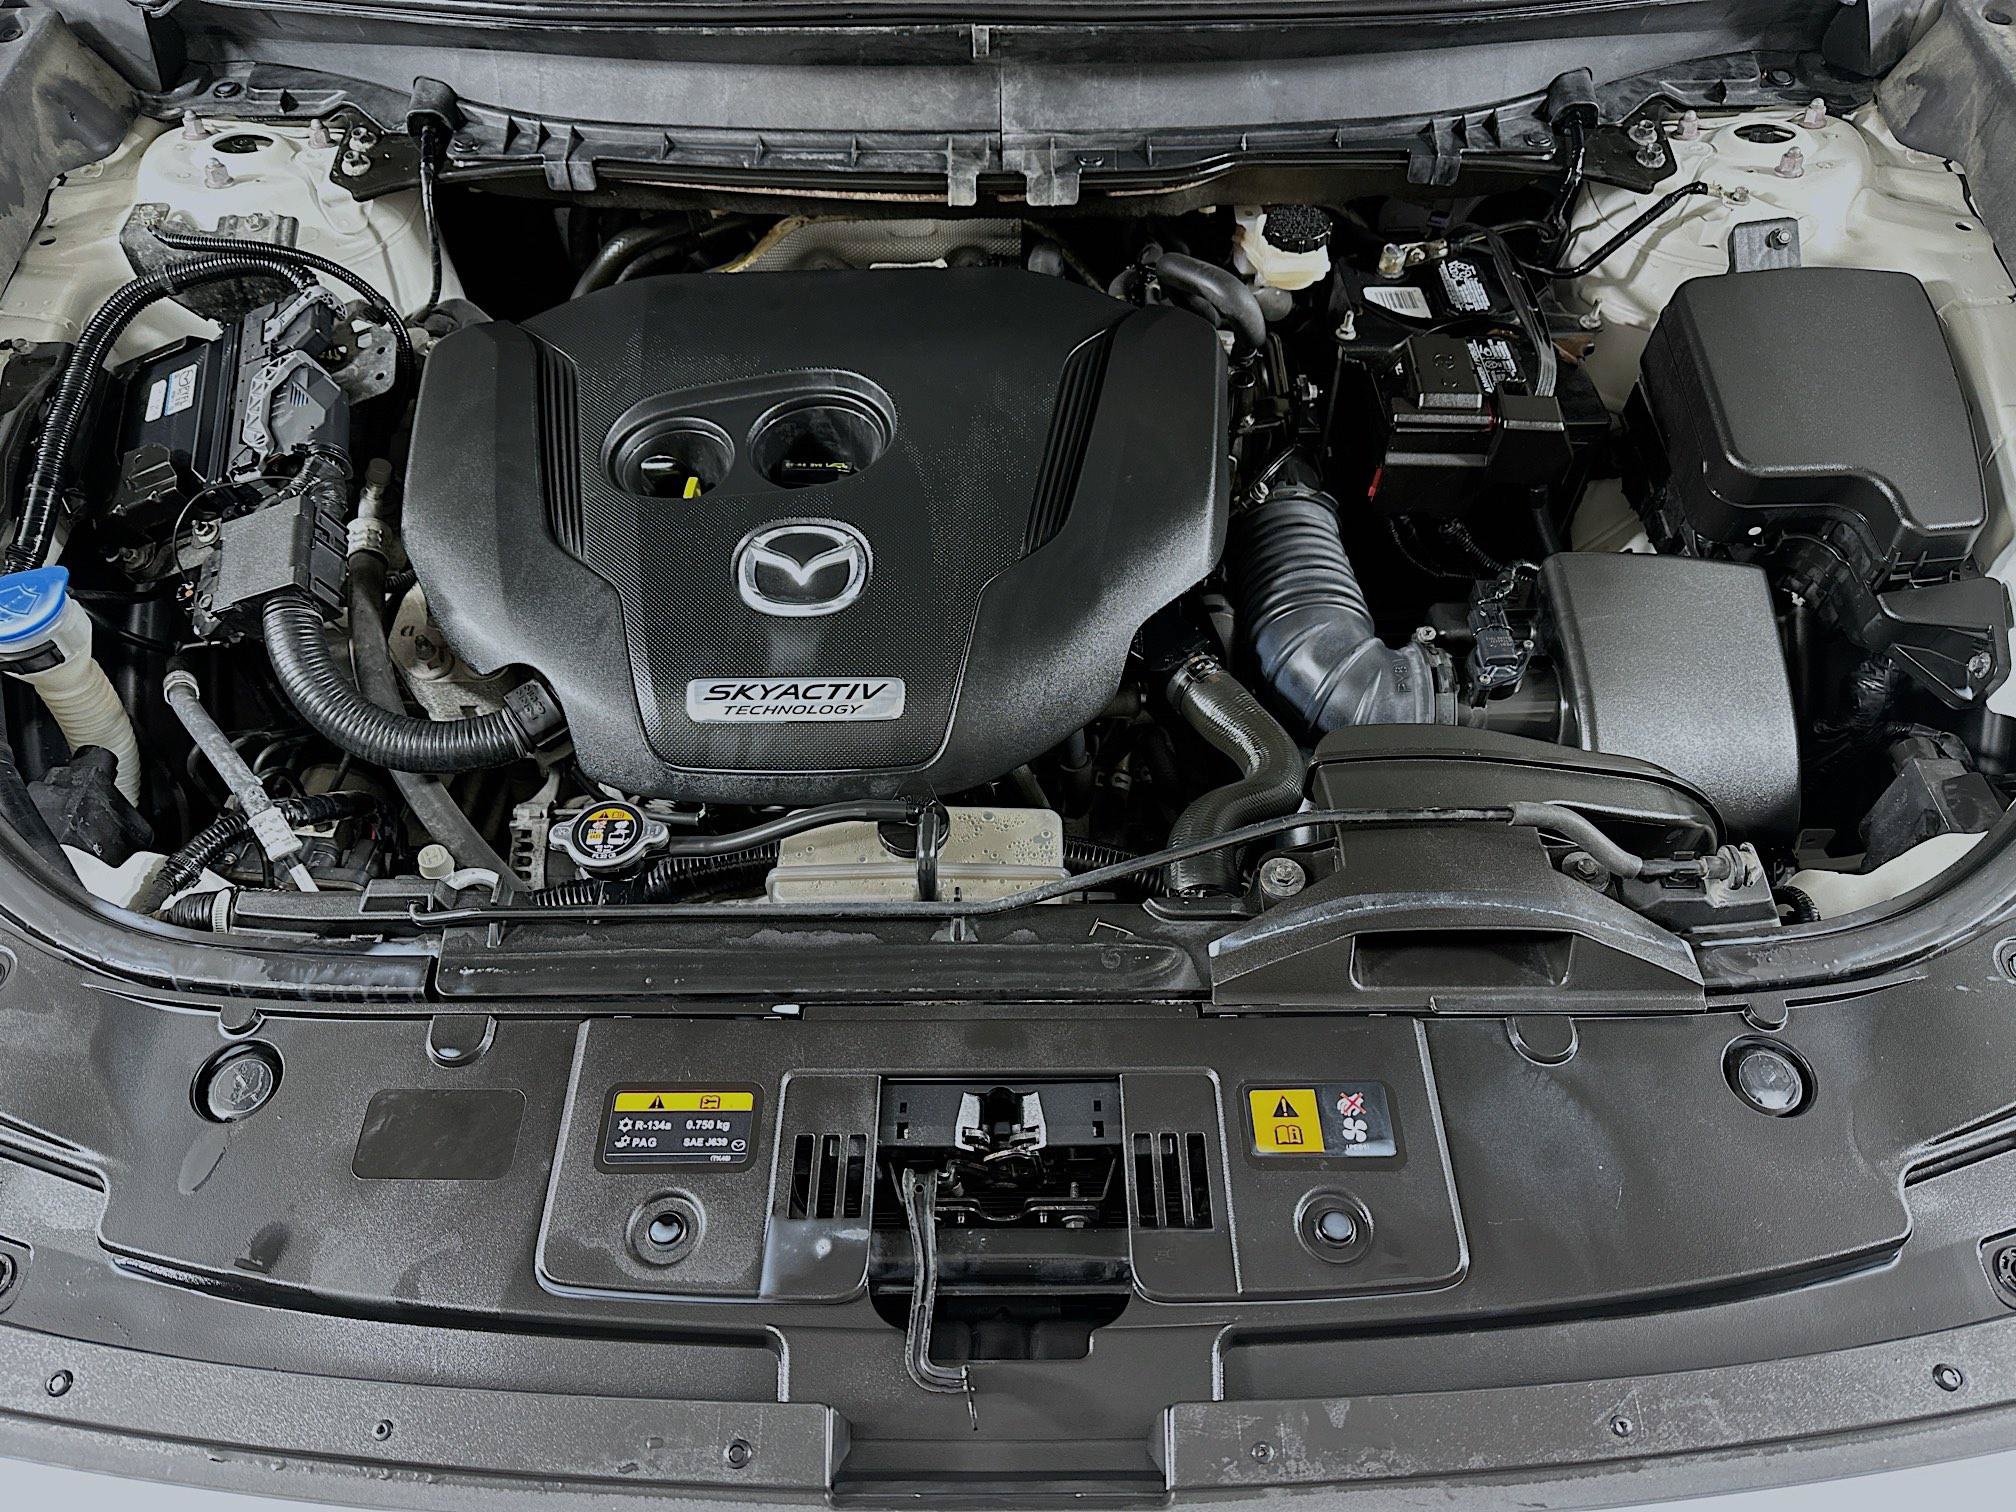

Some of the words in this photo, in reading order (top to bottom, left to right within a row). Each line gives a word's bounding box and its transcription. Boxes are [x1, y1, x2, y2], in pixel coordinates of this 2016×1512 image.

[704, 683, 889, 701] SKYACTIV
[723, 704, 864, 716] TECHNOLOGY
[634, 1120, 672, 1131] R-134a
[685, 1119, 715, 1130] 0.750
[716, 1120, 731, 1132] kg
[631, 1137, 658, 1148] PAG
[682, 1137, 704, 1147] SAE
[705, 1137, 729, 1147] J639
